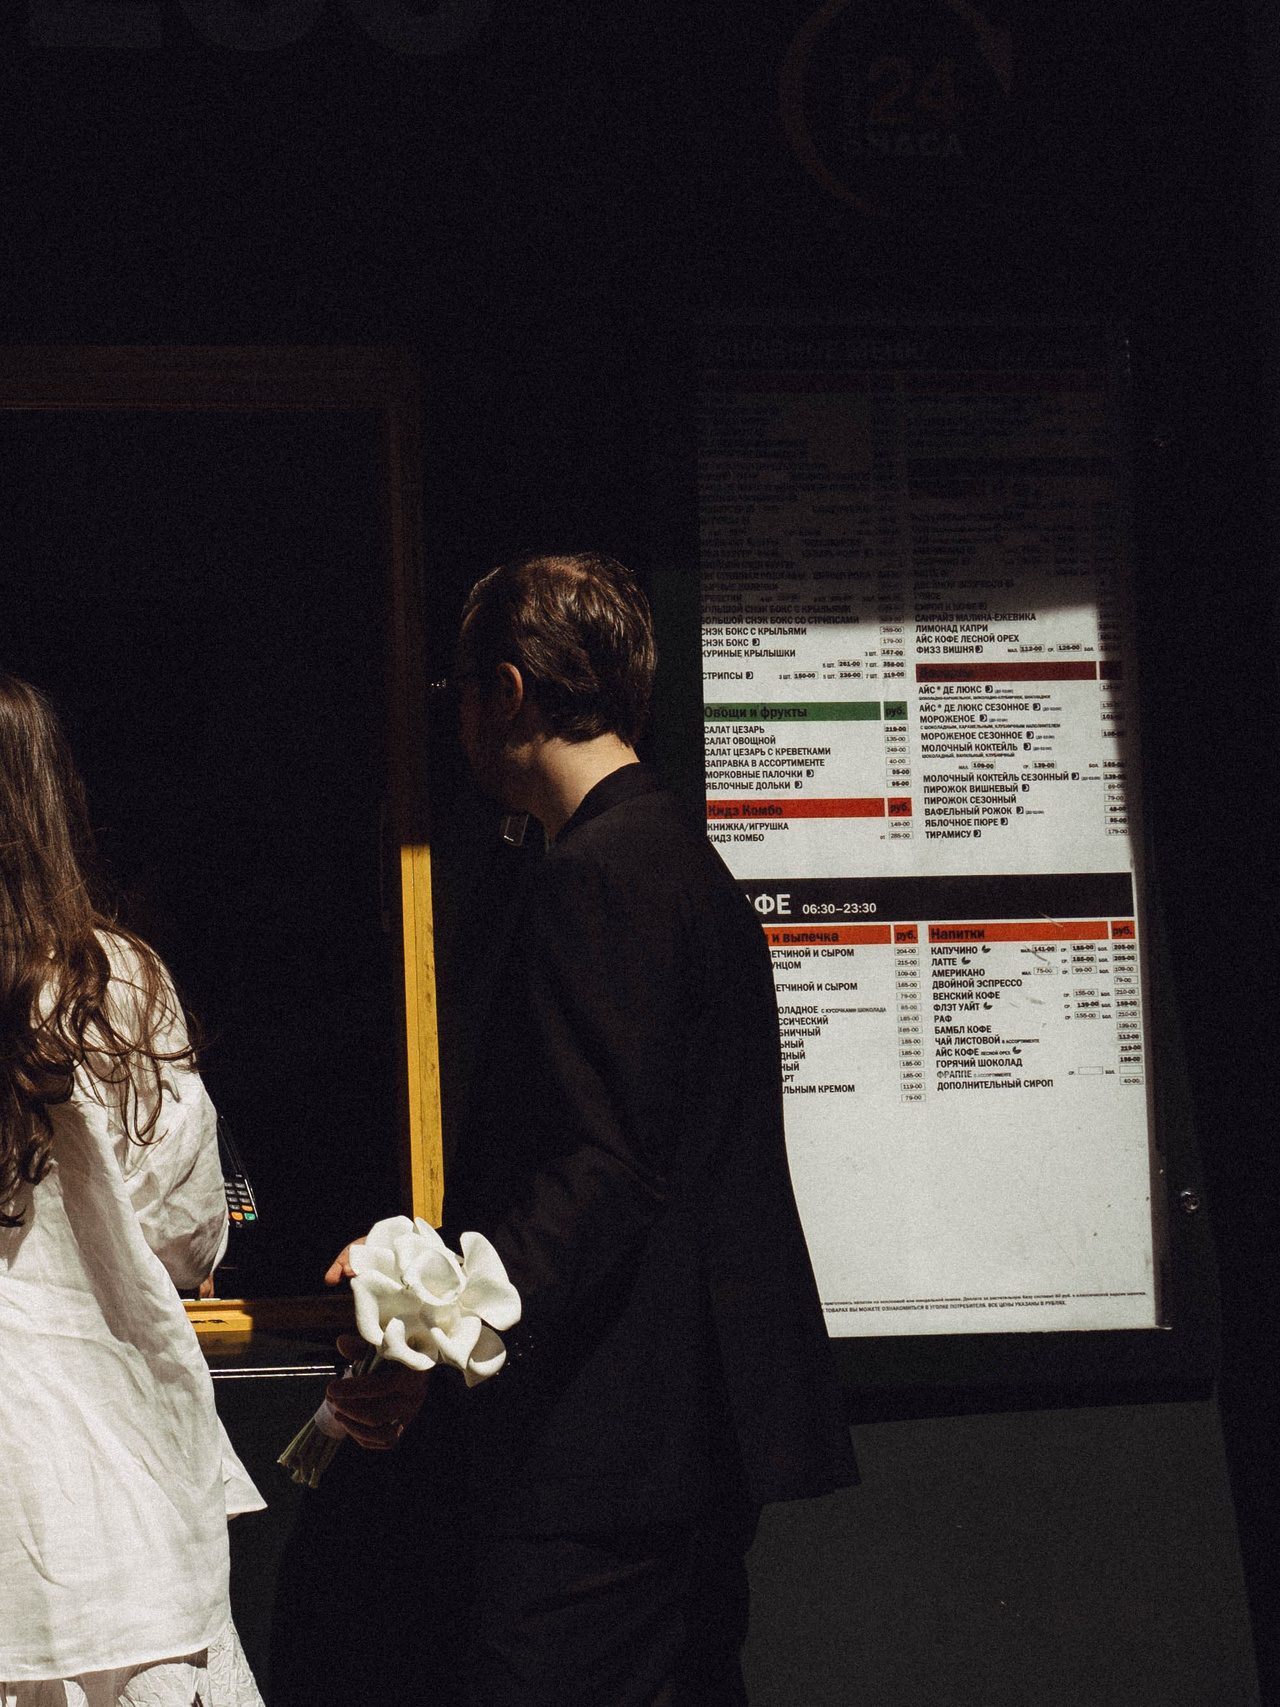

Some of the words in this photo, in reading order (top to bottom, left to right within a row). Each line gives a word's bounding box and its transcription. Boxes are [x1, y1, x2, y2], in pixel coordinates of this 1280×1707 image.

[770, 616, 793, 624] БОКС
[795, 616, 806, 624] СО
[701, 627, 724, 635] СНЭК
[726, 627, 749, 635] БОКС
[750, 627, 756, 635] С
[758, 627, 807, 635] КРЫЛЬЯМИ
[915, 625, 958, 634] ЛИМОНАД
[960, 624, 988, 632] КАПРИ
[916, 634, 933, 643] АЙС
[935, 635, 958, 643] КОФЕ
[961, 633, 995, 642] ЛЕСНОЙ
[744, 649, 796, 657] КРЫЛЫШКИ
[916, 646, 941, 654] ФИЗЗ
[943, 645, 974, 653] ВИШНЯ
[702, 672, 743, 680] СТРИПСЫ
[943, 686, 954, 695] ДЕ
[956, 685, 982, 694] ЛЮКС
[704, 707, 746, 719] Овощи
[761, 706, 807, 719] фрукты
[885, 706, 905, 717] руб.
[944, 703, 955, 712] ДЕ
[957, 703, 983, 711] ЛЮКС
[985, 703, 1029, 711] СЕЗОННОЕ
[920, 714, 975, 723] МОРОЖЕНОЕ
[732, 726, 764, 735] ЦЕЗАРЬ
[921, 732, 976, 740] МОРОЖЕНОЕ
[978, 731, 1022, 739] СЕЗОННОЕ
[704, 737, 730, 745] САЛАТ
[733, 735, 776, 745] ОВОЩНОЙ
[922, 741, 973, 752] МОЛОЧНЫЙ
[975, 741, 1018, 751] КОКТЕЙЛЬ
[705, 748, 731, 756] САЛАТ
[734, 748, 766, 757] ЦЕЗАРЬ
[775, 747, 831, 755] КРЕВЕТКАМИ
[705, 759, 749, 767] ЗАПРАВКА
[751, 759, 757, 767] В
[759, 759, 825, 767] АССОРТИМЕНТЕ
[762, 770, 802, 778] ПАЛОЧКИ
[923, 773, 974, 783] МОЛОЧНЫЙ
[977, 772, 1019, 782] КОКТЕЙЛЬ
[1021, 771, 1069, 781] СЕЗОННЫЙ
[706, 782, 754, 790] ЯБЛОЧНЫЕ
[756, 781, 790, 791] ДОЛЬКИ
[924, 785, 968, 793] ПИРОЖОК
[970, 783, 1018, 793] ВИШНЕВЫЙ
[924, 796, 968, 804] ПИРОЖОК
[970, 794, 1016, 804] СЕЗОННЫЙ
[709, 806, 739, 817] Кидз
[742, 804, 783, 816] Комбо
[890, 803, 910, 813] руб.
[925, 805, 980, 816] ВАФЕЛЬНЫЙ
[982, 807, 1012, 815] РОЖОК
[707, 822, 789, 831] КНИЖКА/ИГРУШКА
[925, 818, 972, 827] ЯБЛОЧНОЕ
[974, 818, 998, 826] ПЮРЕ
[708, 834, 731, 843] КИДЗ
[734, 834, 764, 842] КОМБО
[925, 830, 971, 839] ТИРАМИСУ
[746, 893, 791, 916] ФЕ
[896, 931, 916, 941] руб.
[931, 928, 985, 939] Напитки
[1112, 926, 1132, 936] руб.
[783, 933, 839, 943] выпечка
[772, 948, 811, 958] ЕТЧИНОЙ
[821, 949, 854, 957] СЫРОМ
[931, 947, 978, 955] КАПУЧИНО
[932, 958, 957, 966] ЛАТТЕ
[932, 969, 985, 977] АМЕРИКАНО
[776, 982, 814, 991] ЕТЧИНОЙ
[817, 983, 823, 991] И
[825, 983, 857, 991] СЫРОМ
[932, 978, 975, 990] ДВОЙНОЙ
[977, 979, 1022, 988] ЭСПРЕССО
[933, 989, 973, 1000] ВЕНСКИЙ
[976, 991, 1000, 999] КОФЕ
[934, 1003, 957, 1012] ФЛЭТ
[959, 1001, 980, 1011] УАЙТ
[779, 1015, 828, 1025] ССИЧЕСКИЙ
[934, 1015, 952, 1023] РАФ
[935, 1026, 965, 1034] БАМБЛ
[967, 1025, 991, 1034] КОФЕ
[935, 1035, 952, 1045] ЧАЙ
[954, 1034, 1000, 1044] ЛИСТОВОЙ
[936, 1047, 953, 1057] АЙС
[955, 1048, 979, 1056] КОФЕ
[936, 1058, 975, 1068] ГОРЯЧИЙ
[978, 1058, 1022, 1068] ШОКОЛАД
[937, 1070, 972, 1078] ФРАППЕ
[818, 1085, 855, 1093] КРЕМОМ
[937, 1079, 1021, 1091] ДОПОЛНИТЕЛЬНЫЙ
[1024, 1079, 1053, 1087] СИРОП
